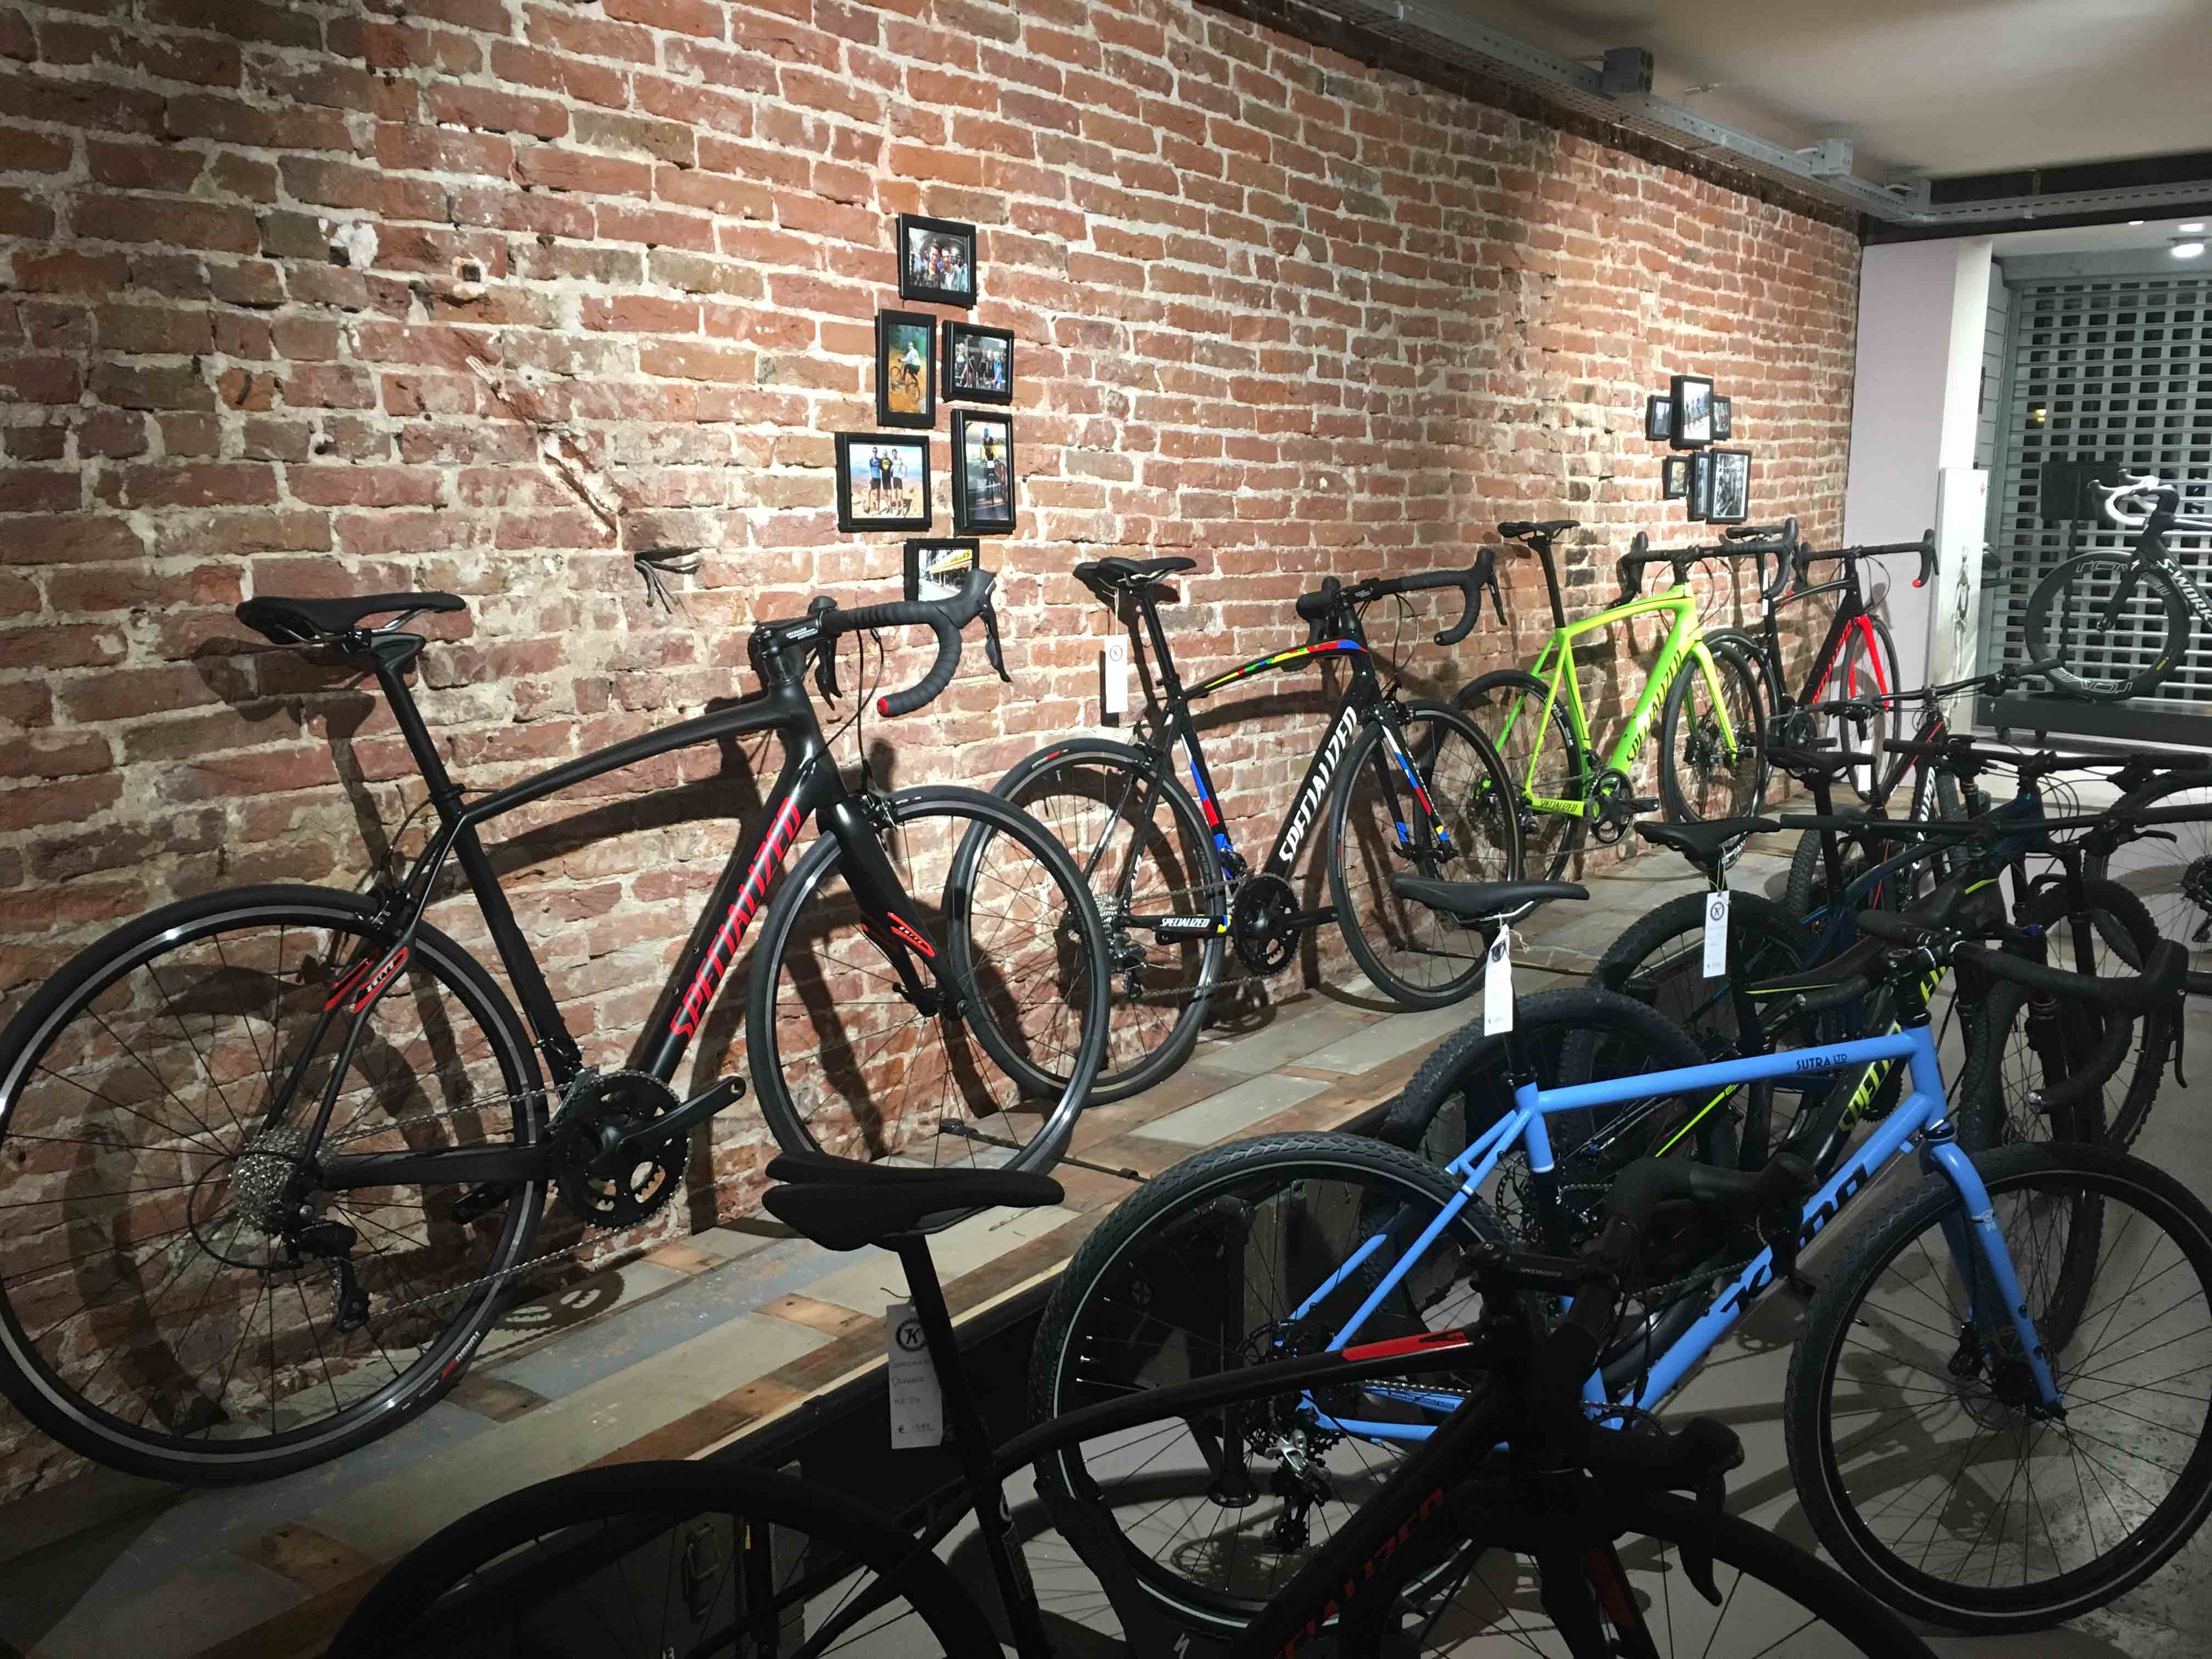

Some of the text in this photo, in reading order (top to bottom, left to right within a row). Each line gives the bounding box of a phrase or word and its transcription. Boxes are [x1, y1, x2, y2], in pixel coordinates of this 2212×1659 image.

[1278, 706, 1359, 862] SPECIALIZED
[669, 796, 803, 1041] SPECIALIZED
[1160, 917, 1210, 928] SPECIALIZED
[1796, 1053, 1848, 1071] SUTRA LTD
[1720, 1163, 1867, 1313] Kna
